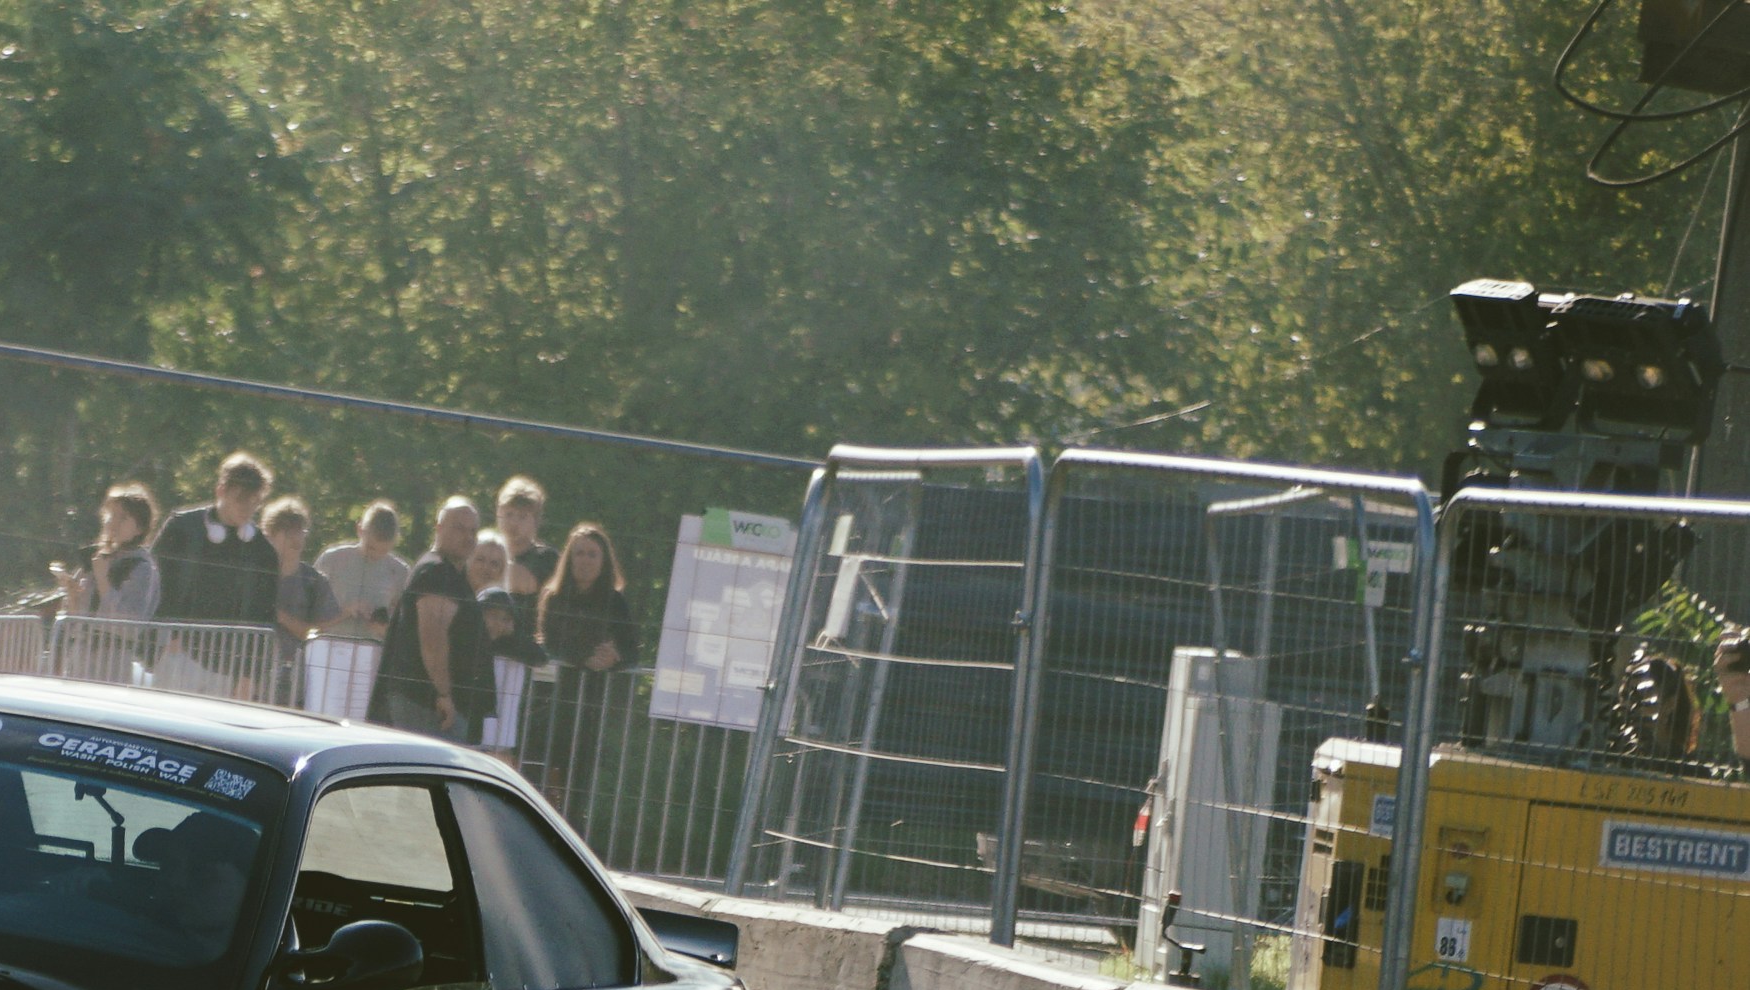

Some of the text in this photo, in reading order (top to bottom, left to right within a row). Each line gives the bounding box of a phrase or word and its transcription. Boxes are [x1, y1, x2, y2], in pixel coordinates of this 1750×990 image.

[60, 749, 188, 785] WASH POLISH WAX
[1614, 833, 1744, 868] BESTRENT
